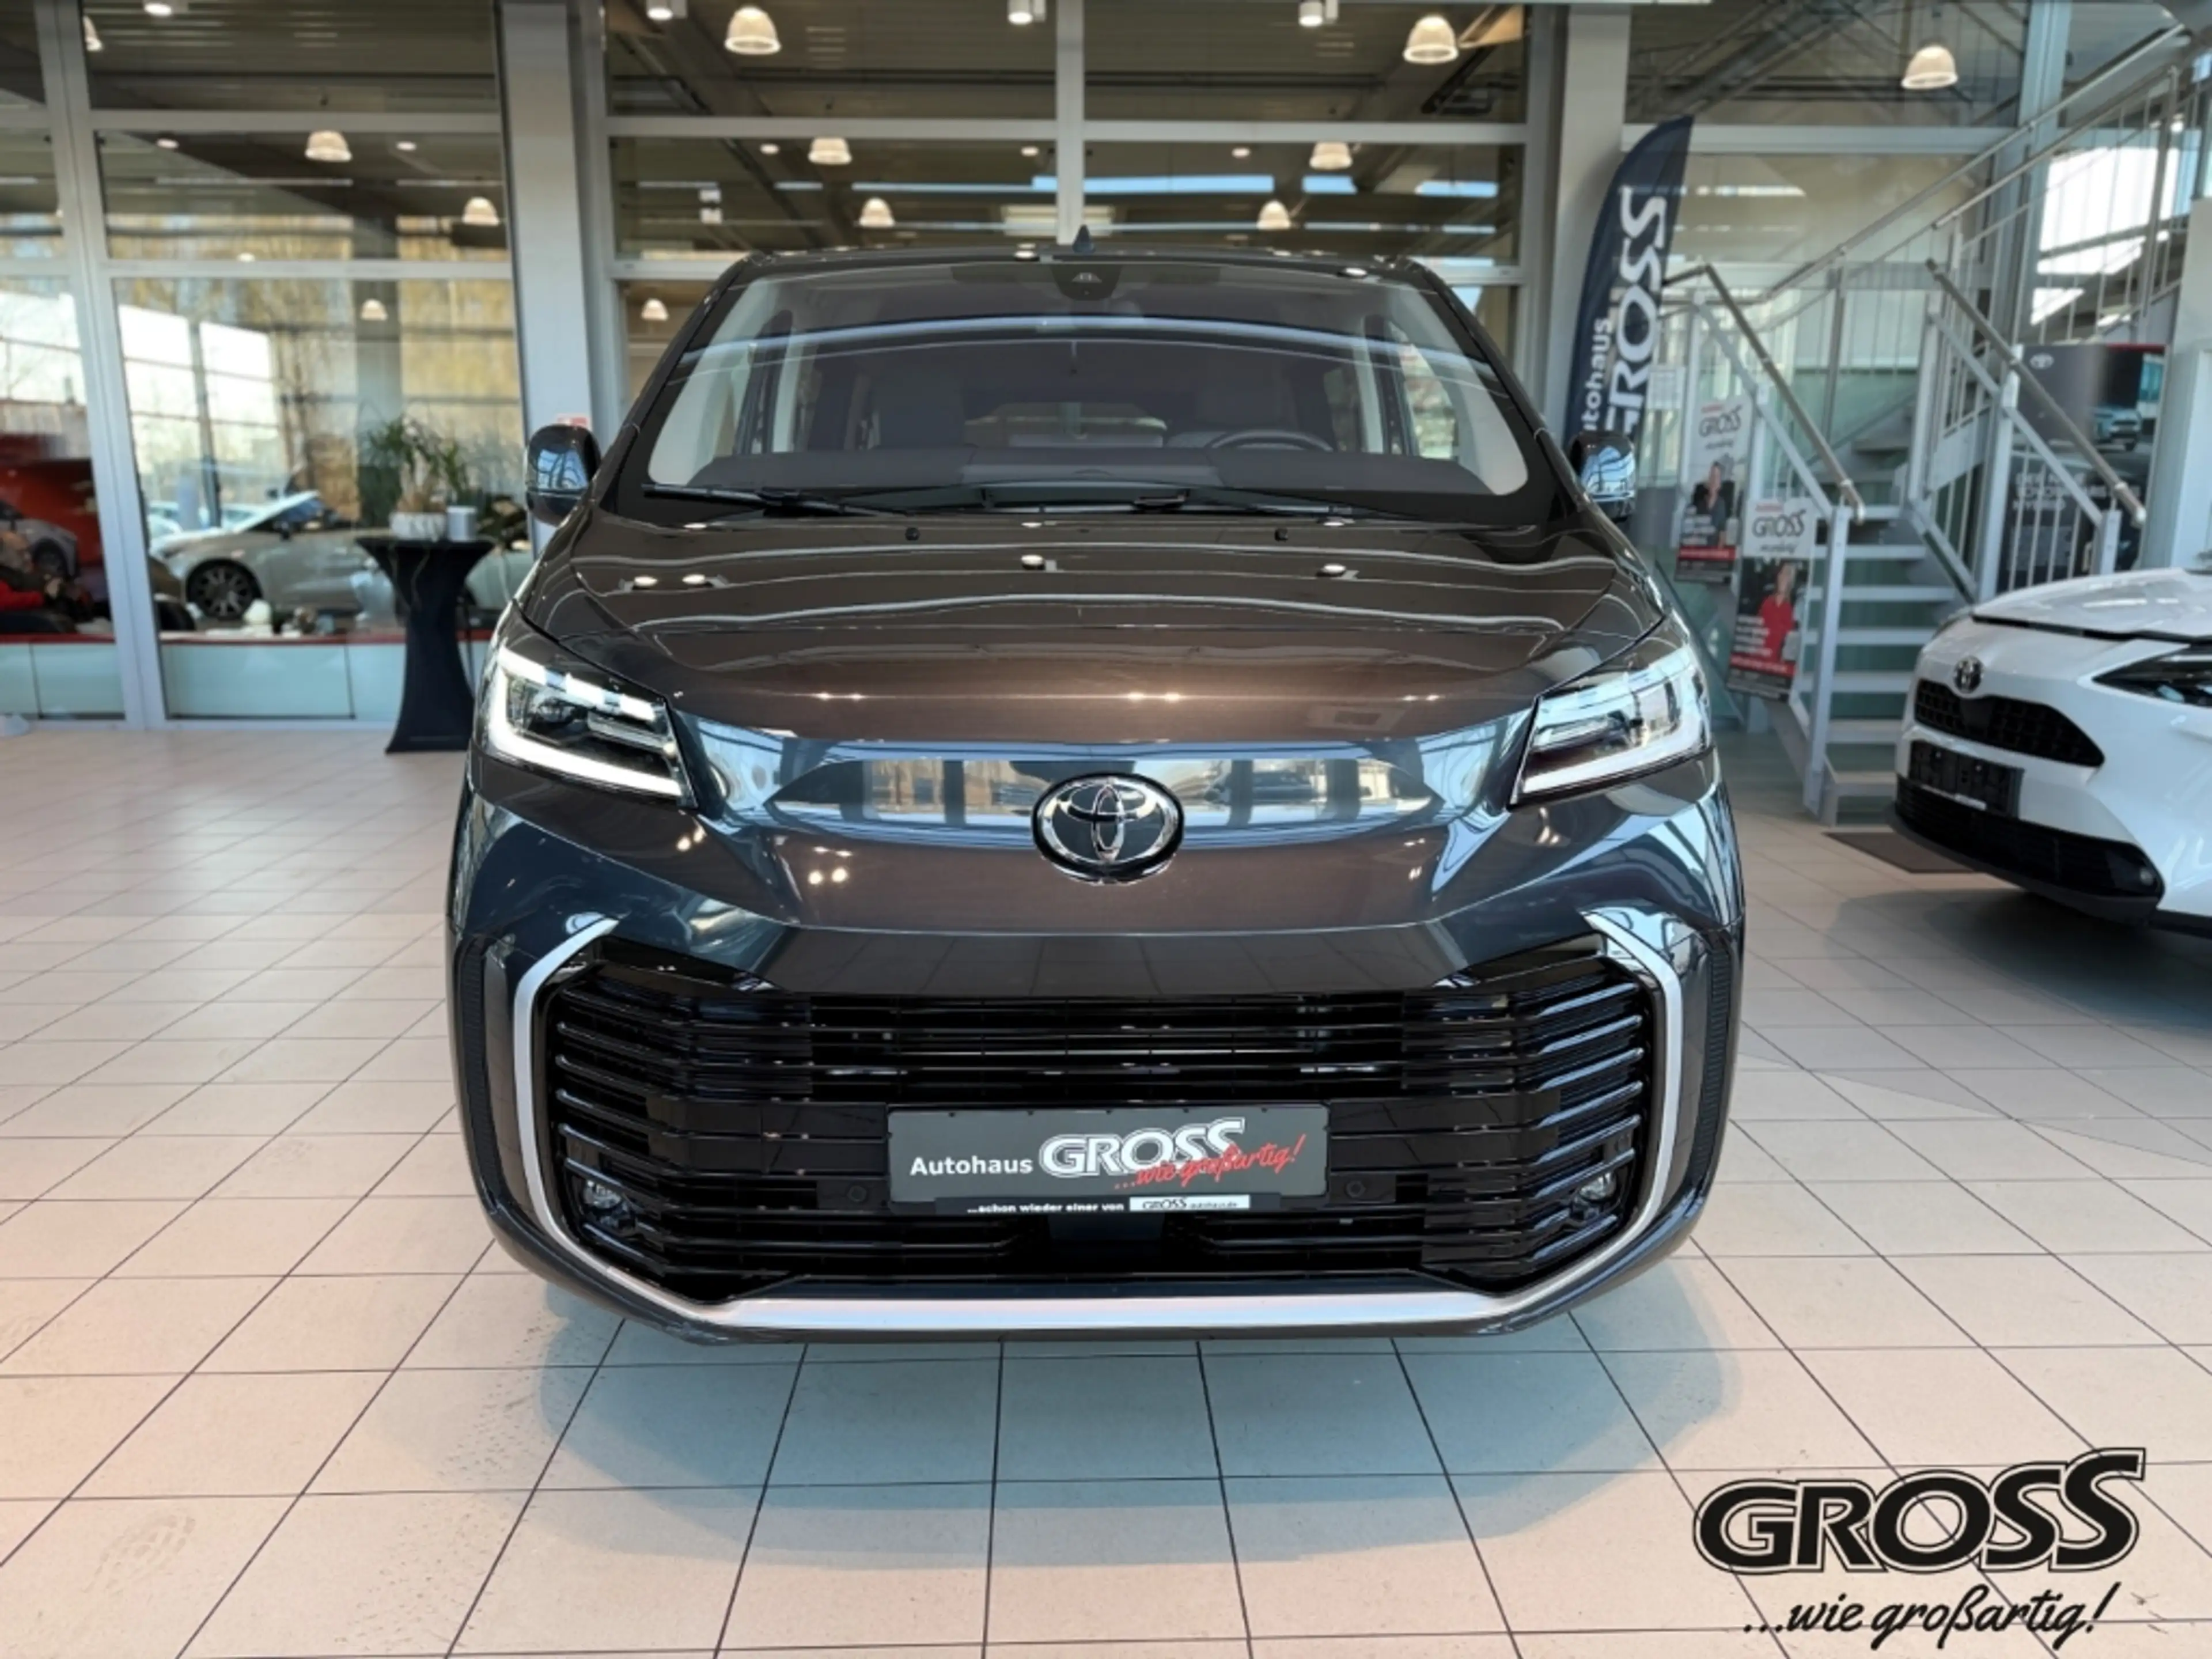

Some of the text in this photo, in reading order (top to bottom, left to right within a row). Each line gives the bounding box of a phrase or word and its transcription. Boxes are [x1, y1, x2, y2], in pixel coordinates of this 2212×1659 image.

[910, 1116, 1246, 1178] Autohaus GROSS
[1019, 1202, 1063, 1213] wieder
[1066, 1202, 1098, 1213] einer
[1101, 1202, 1124, 1212] von
